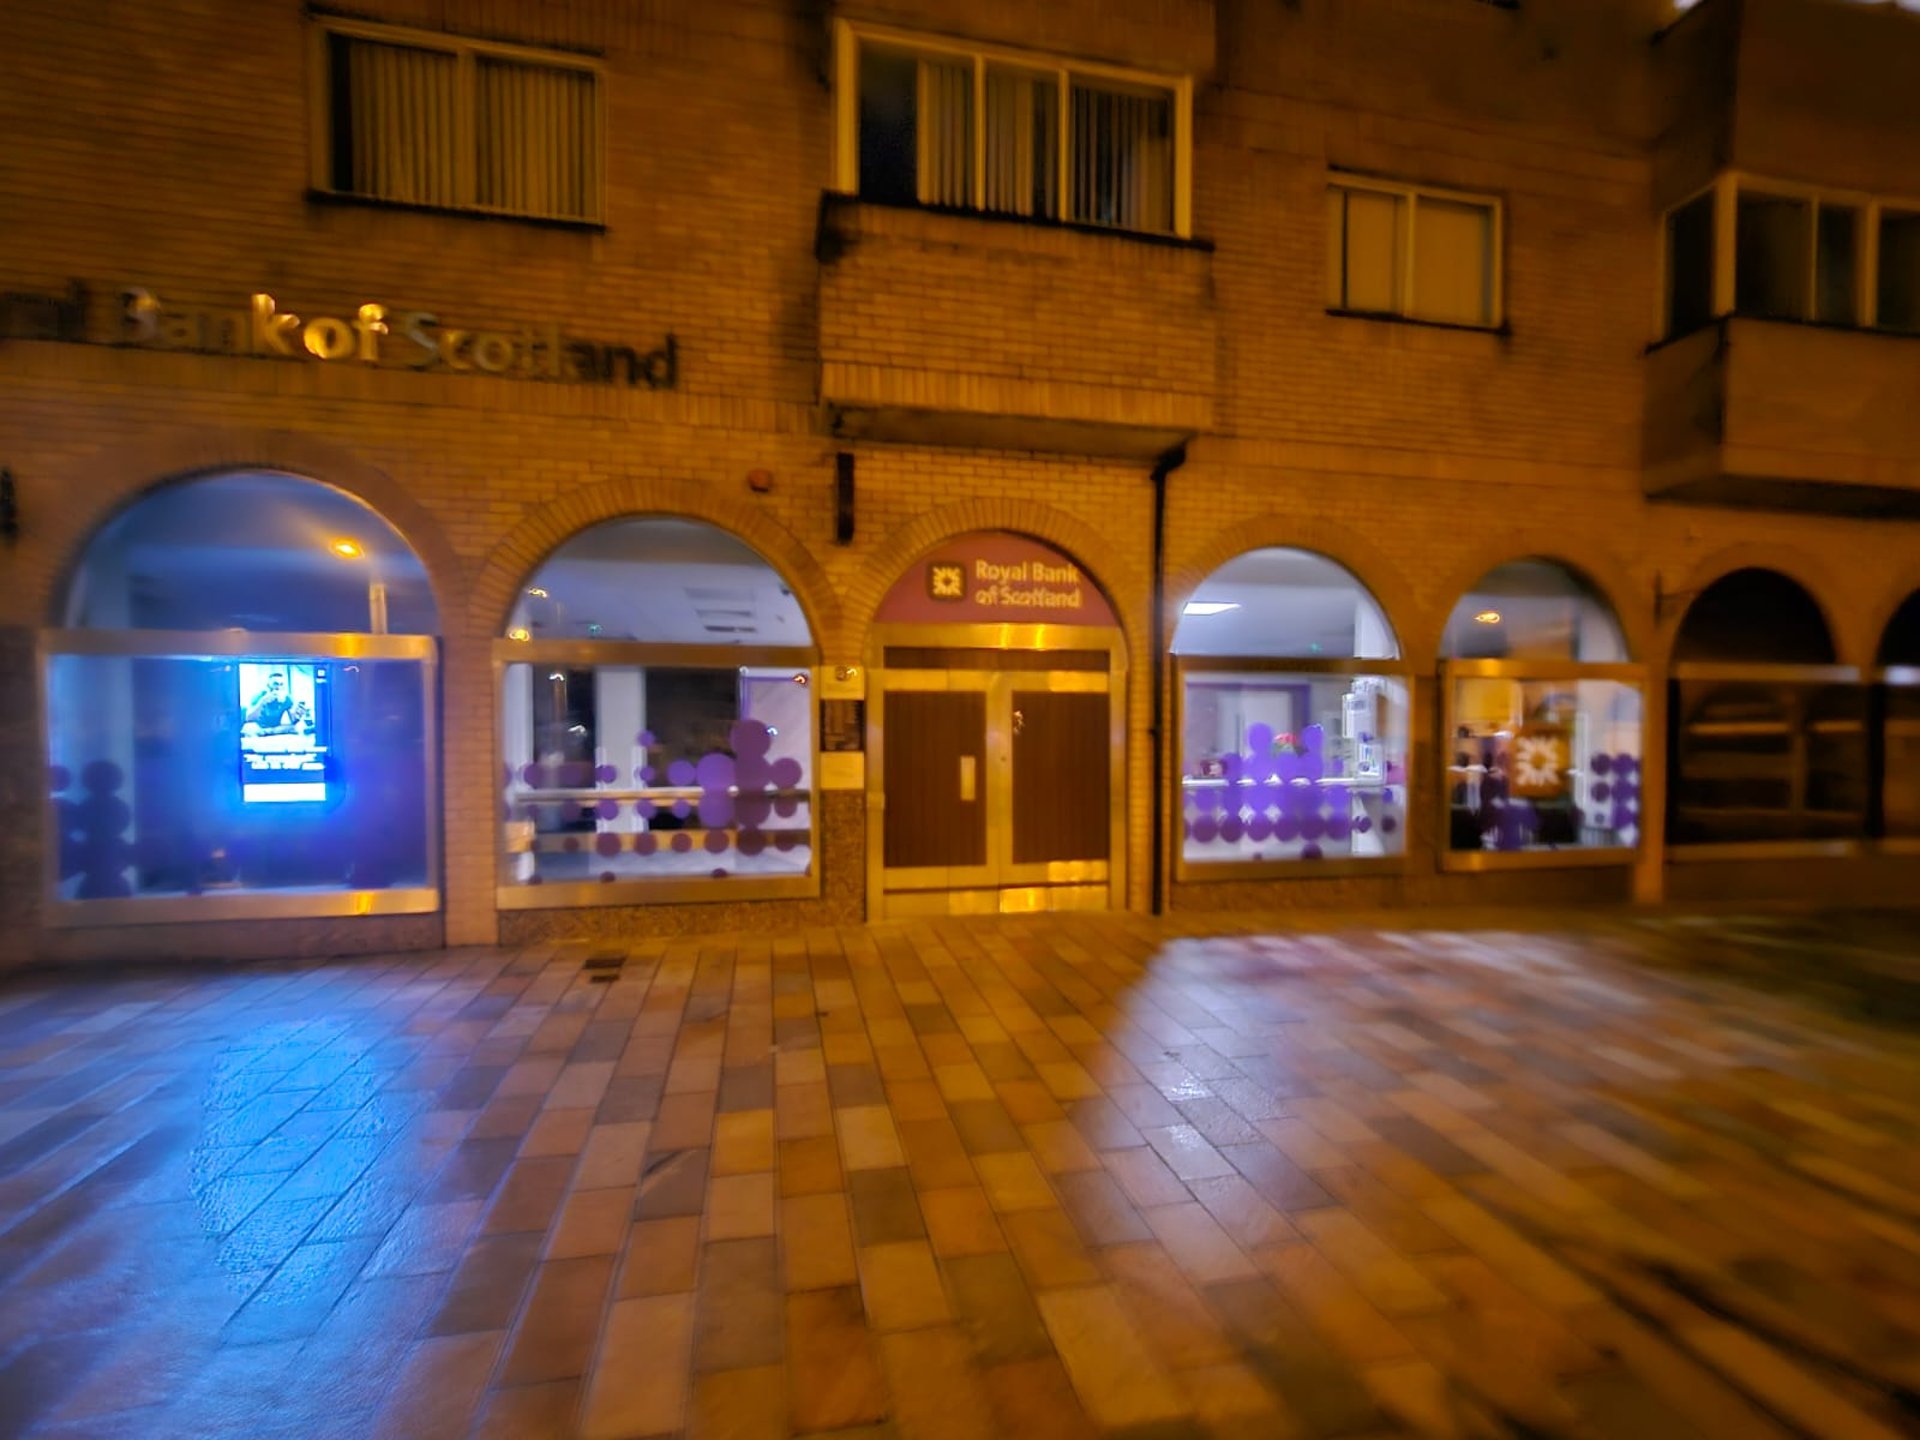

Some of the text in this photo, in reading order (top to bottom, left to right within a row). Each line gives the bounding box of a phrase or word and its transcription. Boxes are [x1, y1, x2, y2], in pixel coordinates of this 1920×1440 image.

[116, 287, 300, 356] Bank
[303, 303, 388, 362] of
[402, 311, 679, 389] Scotland
[976, 559, 1080, 585] Royal Bank
[975, 585, 1082, 608] of Scotland
